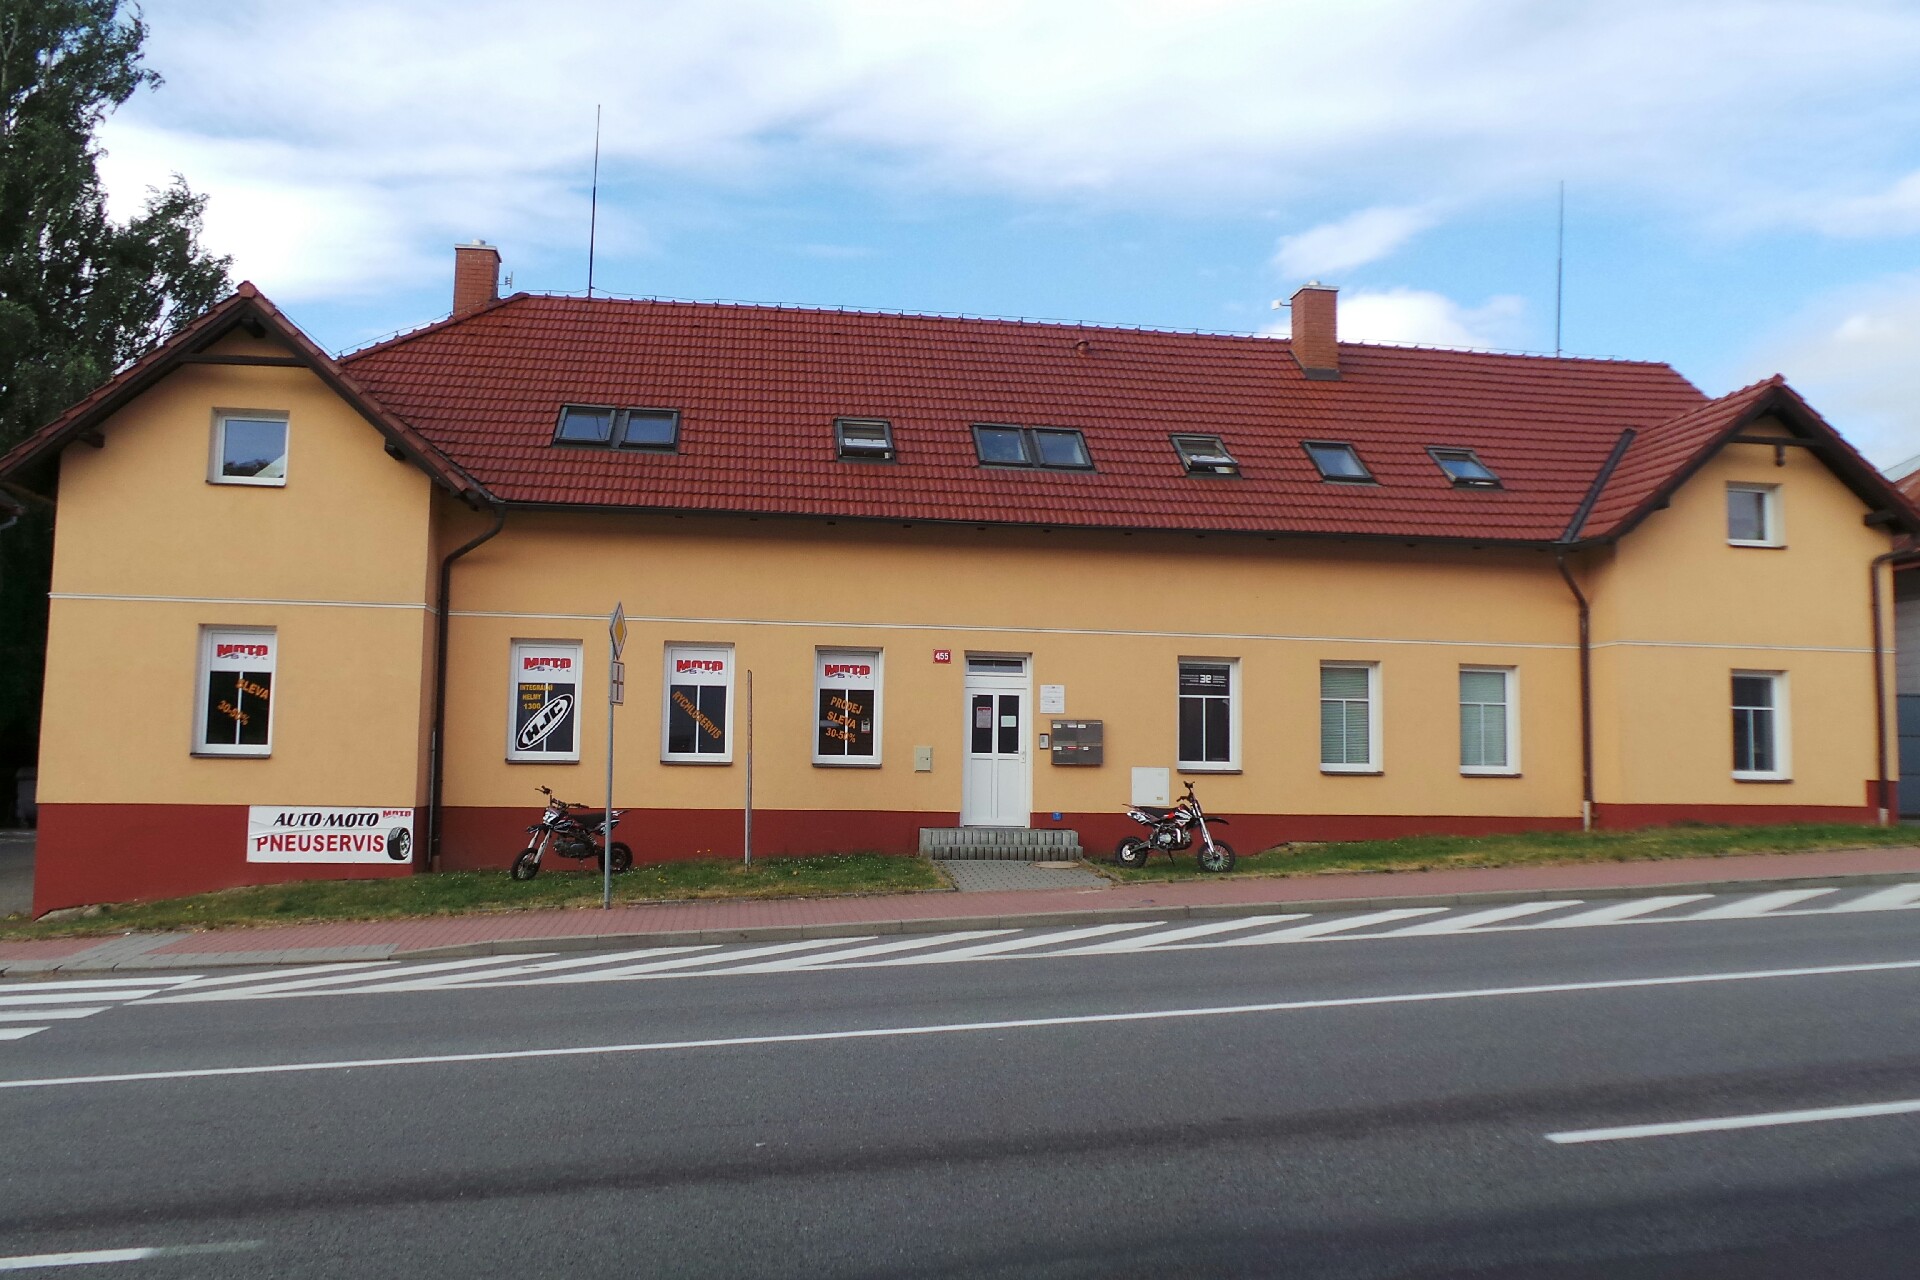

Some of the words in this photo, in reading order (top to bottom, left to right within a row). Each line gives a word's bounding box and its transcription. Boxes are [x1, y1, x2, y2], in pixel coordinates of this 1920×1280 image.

[217, 644, 268, 657] MOTO
[935, 652, 949, 660] 455
[524, 658, 571, 669] MOTO
[676, 660, 723, 672] MOTO
[825, 664, 870, 676] MOTO
[235, 679, 269, 699] SLEVA
[830, 696, 862, 714] PRODEJ
[525, 701, 564, 742] HJC
[672, 691, 722, 739] RYCHLOSERVIS
[827, 711, 856, 729] SLEVA
[256, 835, 384, 852] PNEUSERVIS
